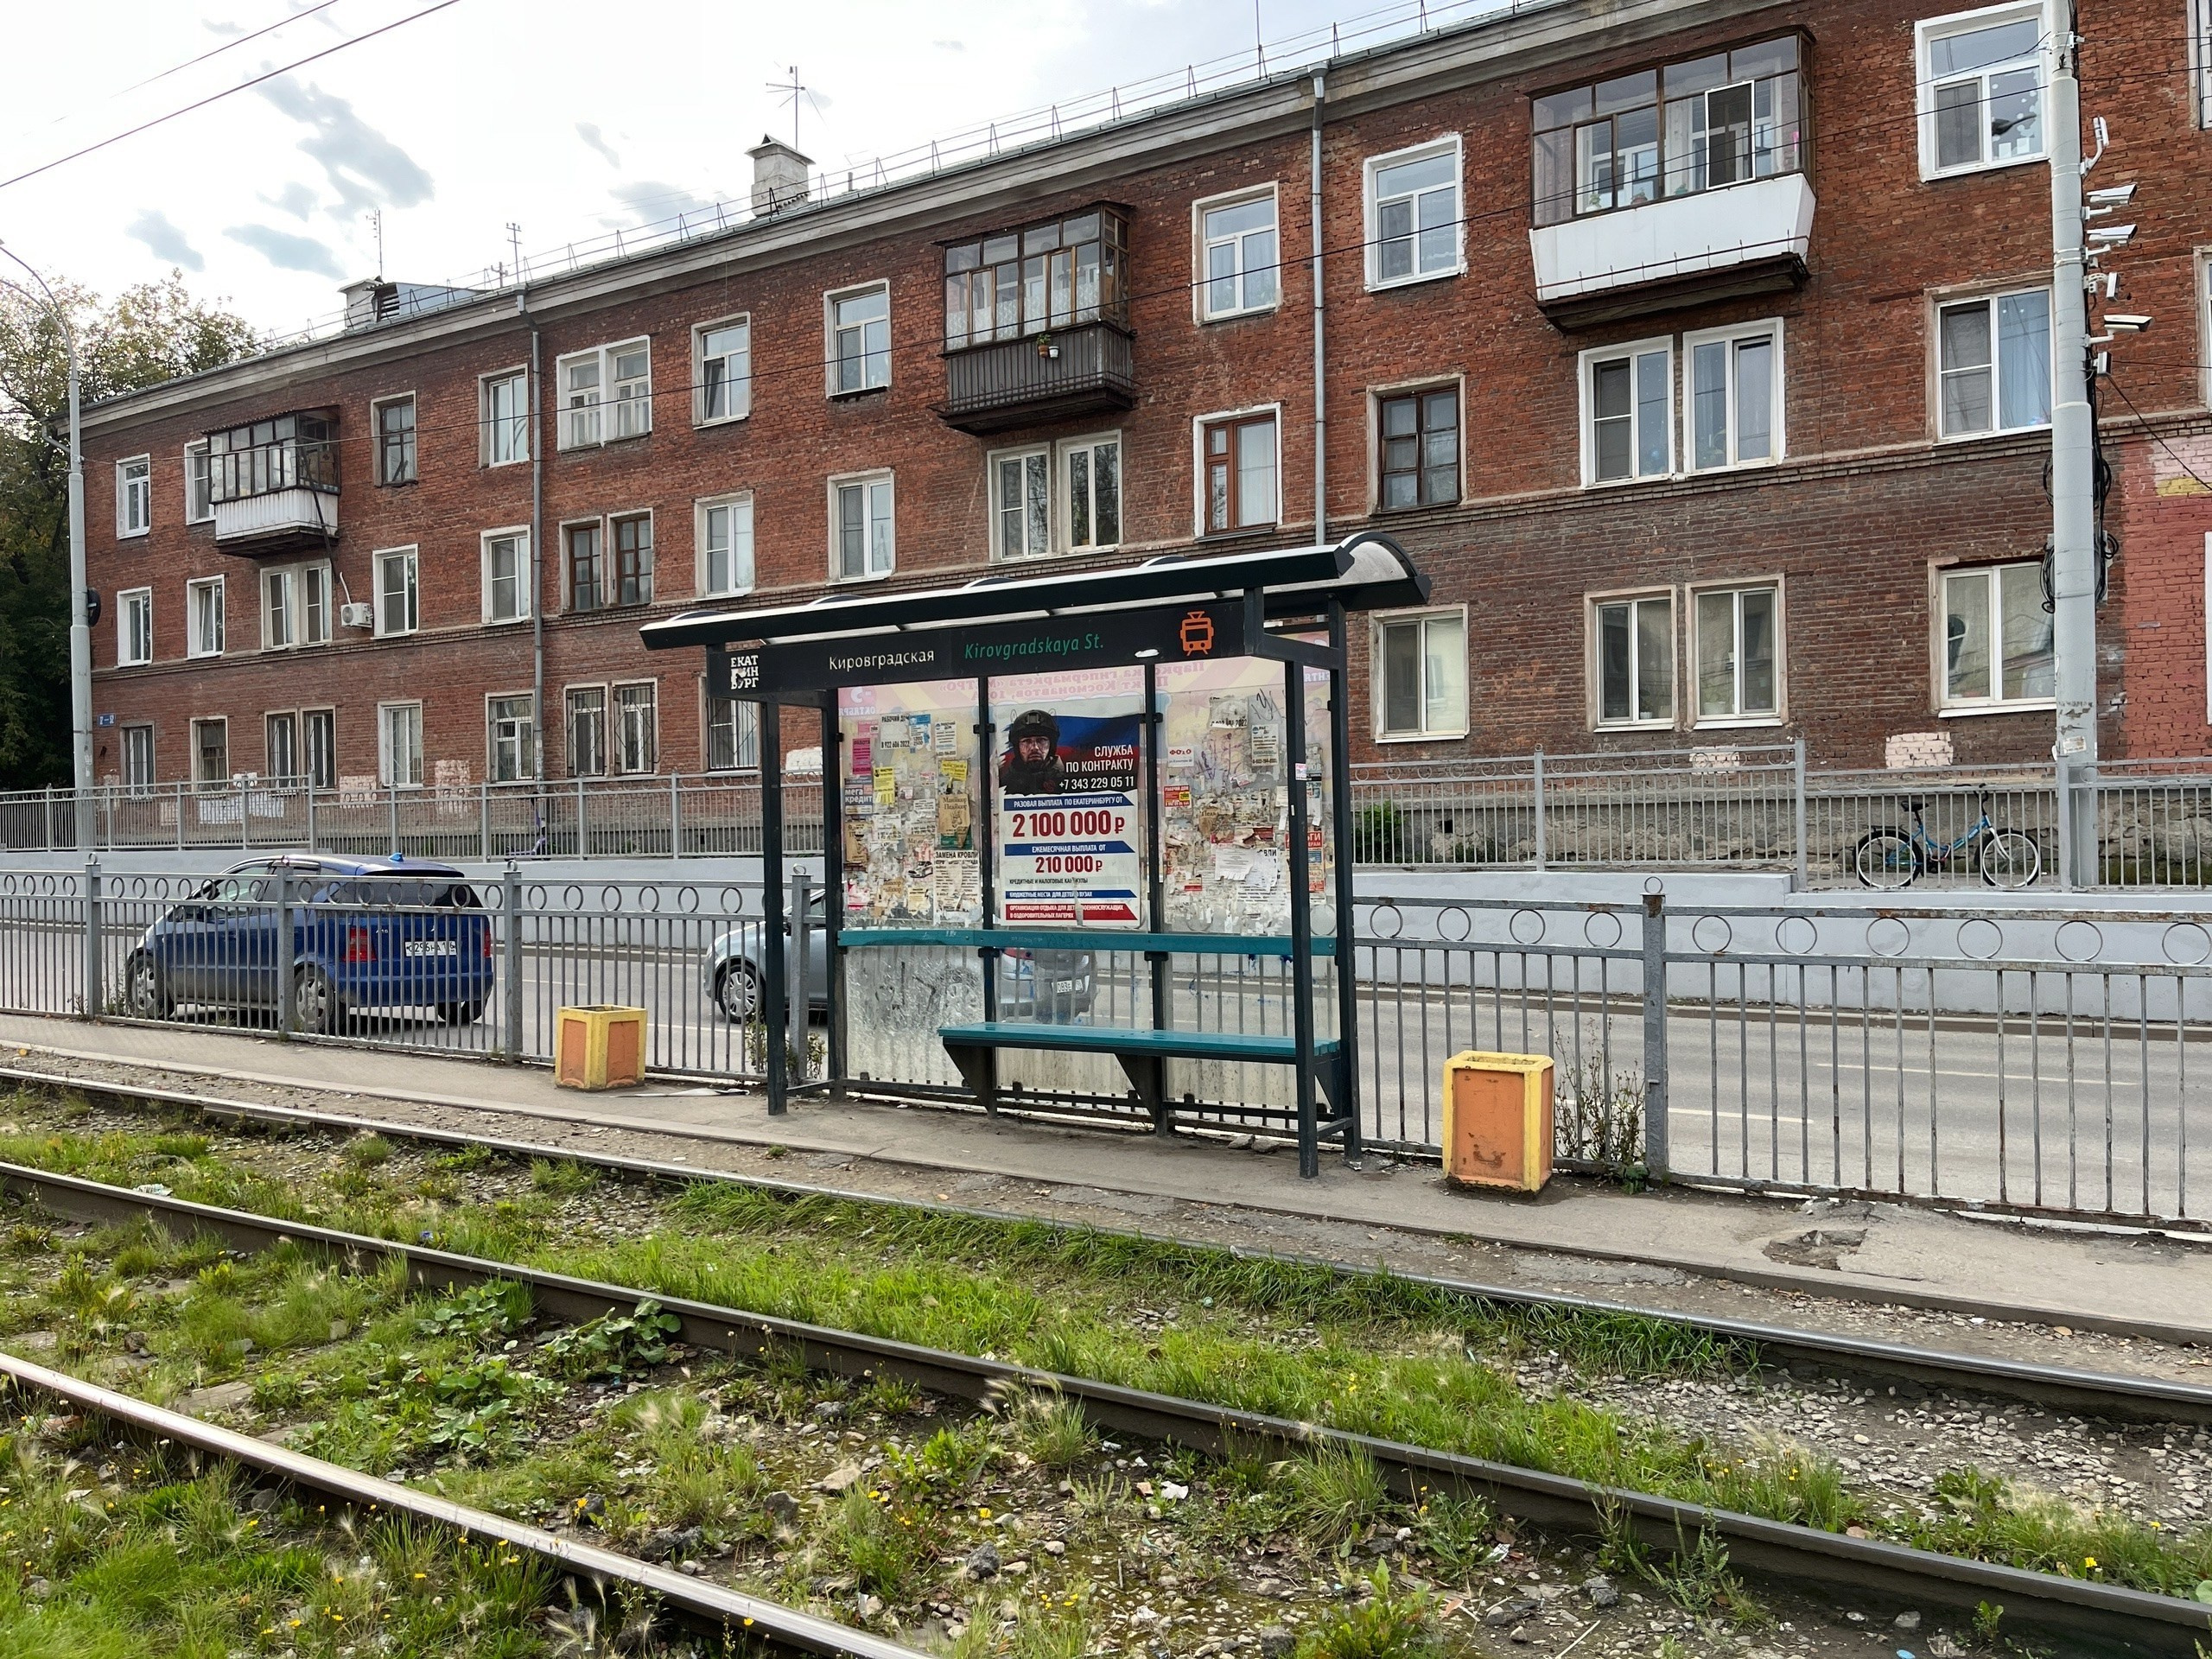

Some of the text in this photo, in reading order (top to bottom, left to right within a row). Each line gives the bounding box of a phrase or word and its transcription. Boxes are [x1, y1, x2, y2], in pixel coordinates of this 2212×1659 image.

[964, 633, 1104, 660] Kirovgradskaya St.
[730, 655, 759, 668] ЕКАТ
[829, 651, 935, 671] Кировградская
[1094, 745, 1134, 758] СЛУЖБА
[1065, 759, 1134, 772] ПО КОНТРАКТУ
[1059, 776, 1135, 790] +7 343 229 05 11
[844, 796, 873, 805] кредит
[1073, 797, 1116, 805] ЕКАТЕРИНБУРГУ
[1012, 813, 1026, 837] 2
[1029, 812, 1065, 837] 100
[1032, 845, 1071, 854] ЕЖЕМЕСЯЧНАЯ
[1036, 856, 1061, 874] 210
